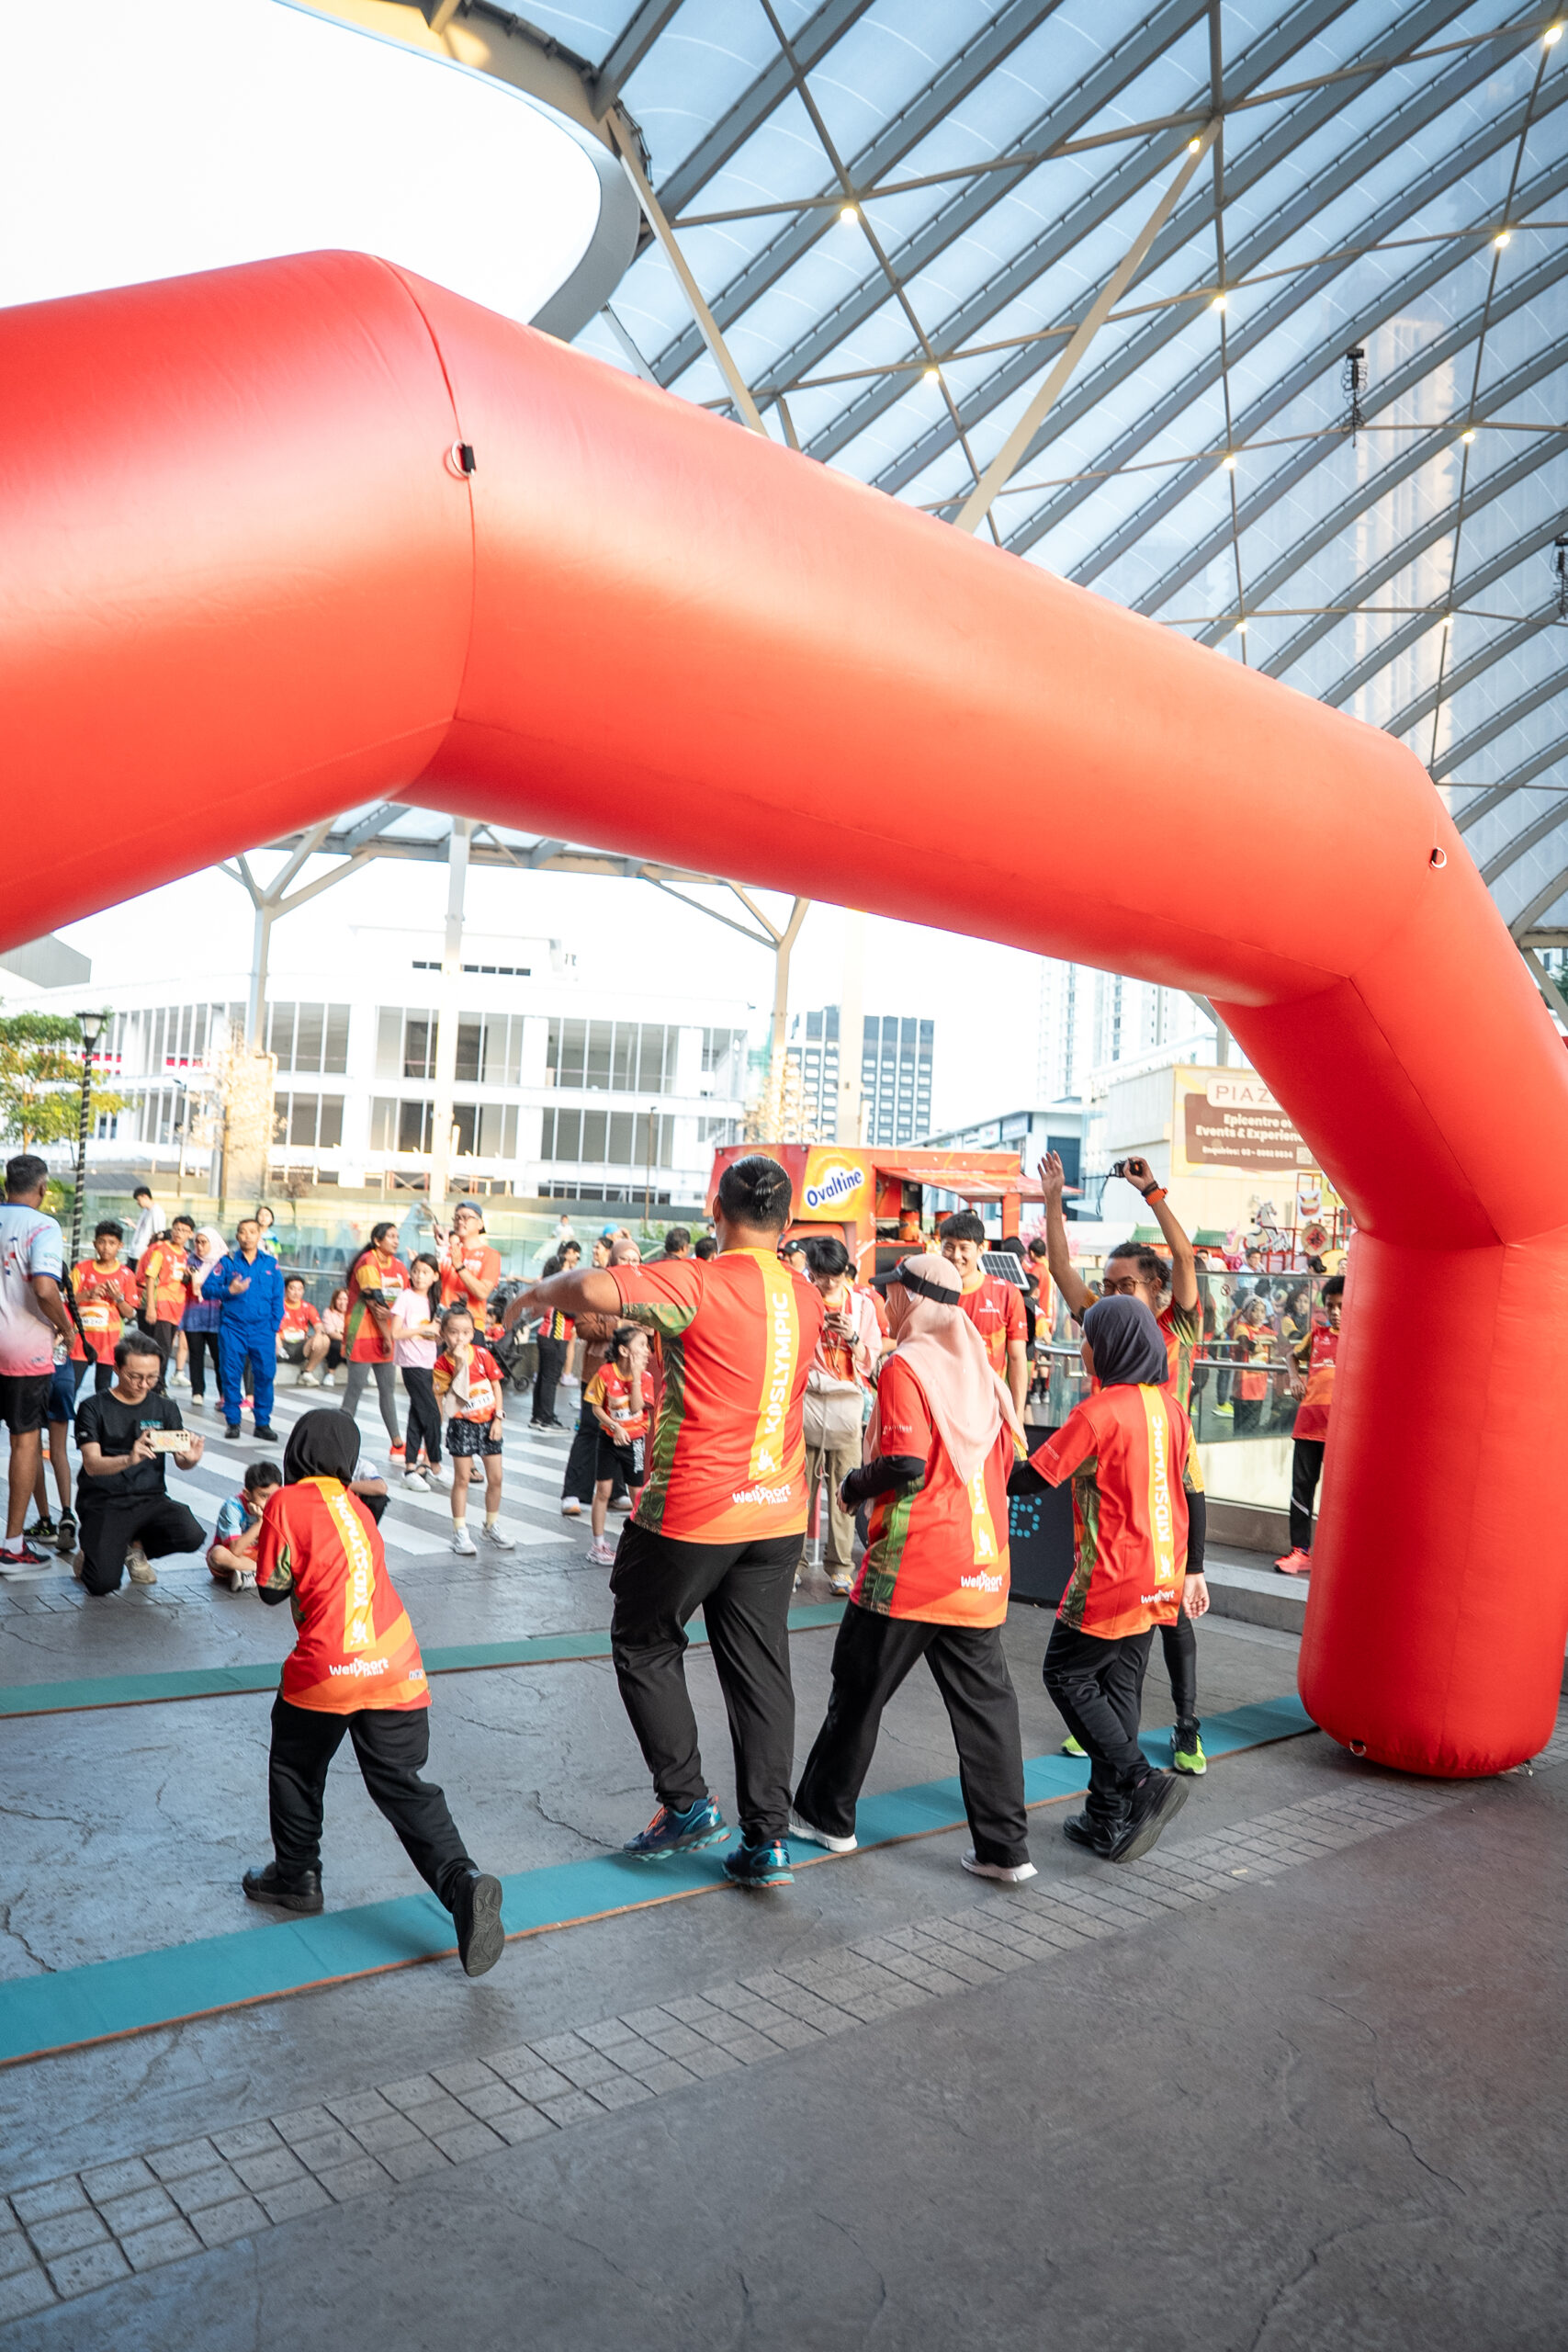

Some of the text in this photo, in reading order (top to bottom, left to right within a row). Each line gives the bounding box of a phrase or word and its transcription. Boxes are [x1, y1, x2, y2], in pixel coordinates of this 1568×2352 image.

[1215, 1085, 1277, 1103] PIAZ
[1224, 1113, 1280, 1128] Epicentre
[1195, 1125, 1303, 1143] Events & Experienc
[807, 1171, 863, 1206] Ovaltine
[1152, 1415, 1169, 1543] KIDSLYMPIC
